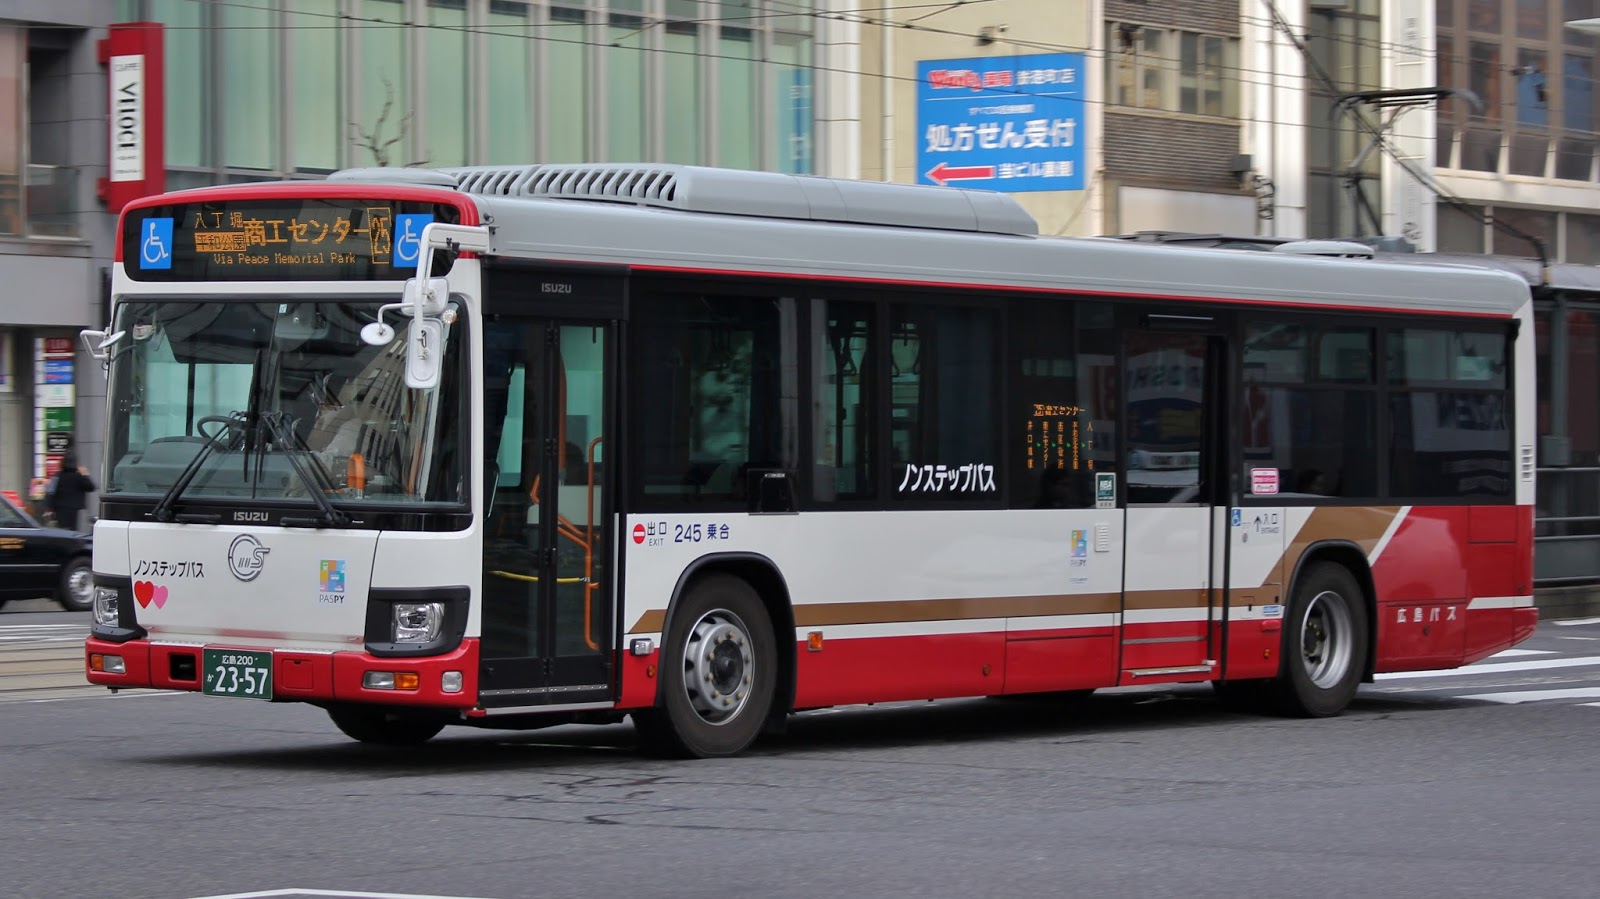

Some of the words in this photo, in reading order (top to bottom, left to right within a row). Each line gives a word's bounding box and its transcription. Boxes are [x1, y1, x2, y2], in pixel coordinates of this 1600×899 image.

[925, 118, 1077, 153] 処方せん受付
[195, 212, 243, 229] 八丁堀
[195, 232, 246, 252] 平和公園
[243, 217, 370, 246] 商工センター
[371, 217, 391, 254] 25
[214, 253, 233, 264] Via
[238, 253, 270, 264] Peace
[274, 252, 325, 264] Memorial
[331, 252, 356, 264] Park
[541, 283, 572, 293] ISUZU
[1045, 405, 1085, 416] 商工センター
[899, 463, 996, 492] ノンステップバス
[233, 511, 269, 521] ISUZU
[1263, 513, 1278, 525] 入口
[647, 521, 667, 536] 出口
[674, 524, 702, 543] 245
[707, 523, 730, 540] 乗合
[649, 538, 664, 546] EXIT
[134, 560, 205, 578] ノンステップバス
[319, 594, 345, 604] PASPY
[207, 674, 214, 682] か
[215, 665, 268, 695] 23-57
